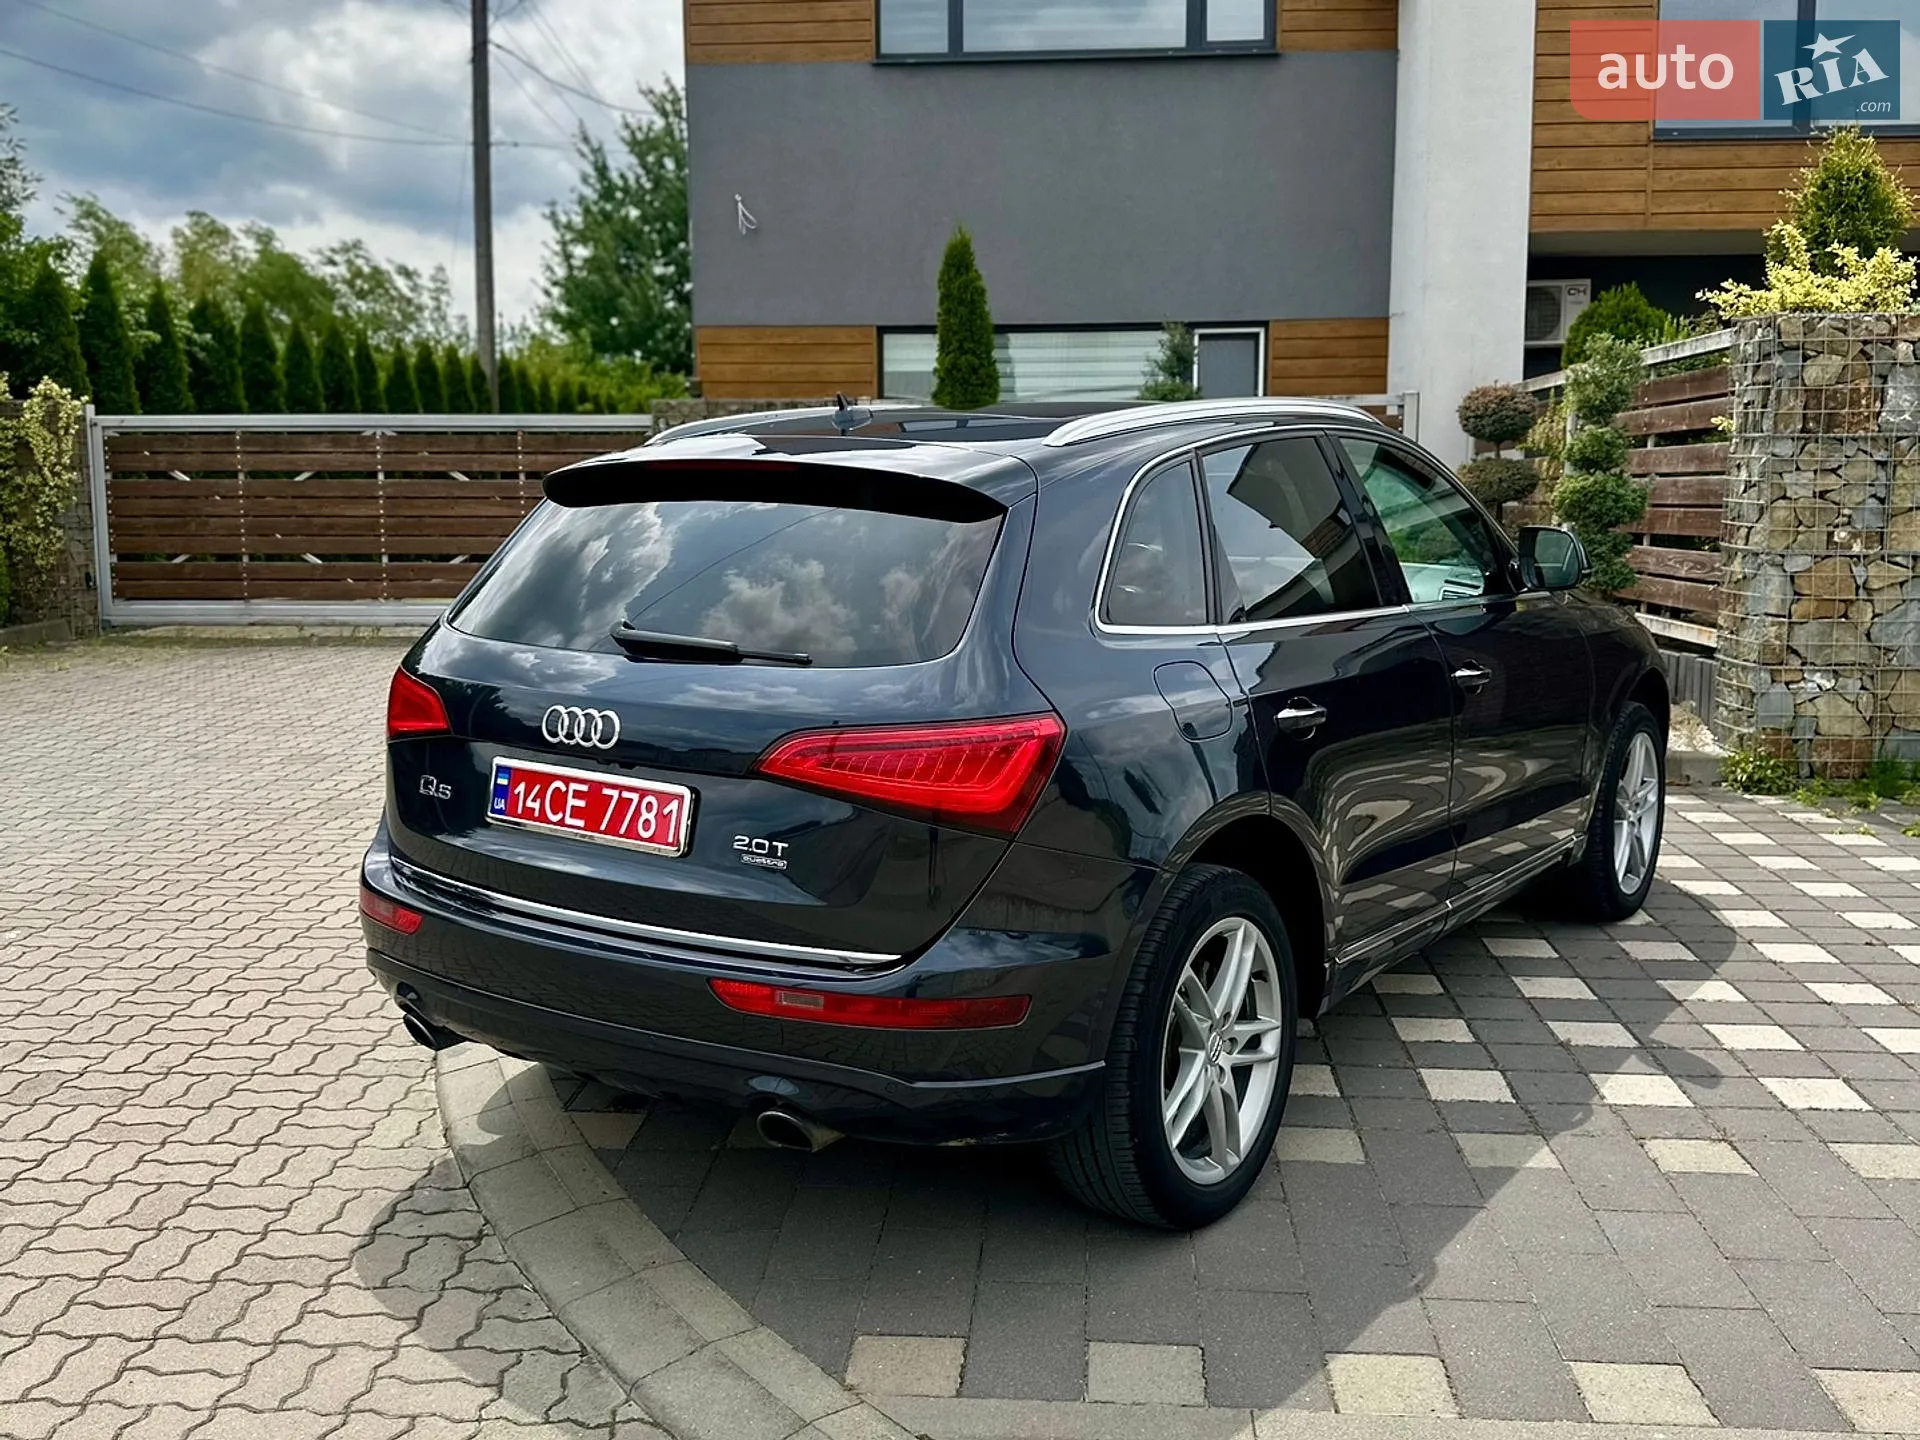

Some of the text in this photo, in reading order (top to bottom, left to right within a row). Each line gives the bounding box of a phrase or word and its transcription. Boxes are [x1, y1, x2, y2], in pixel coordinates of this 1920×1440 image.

[419, 774, 451, 799] Q5
[494, 797, 505, 810] UA
[600, 787, 680, 843] 7781
